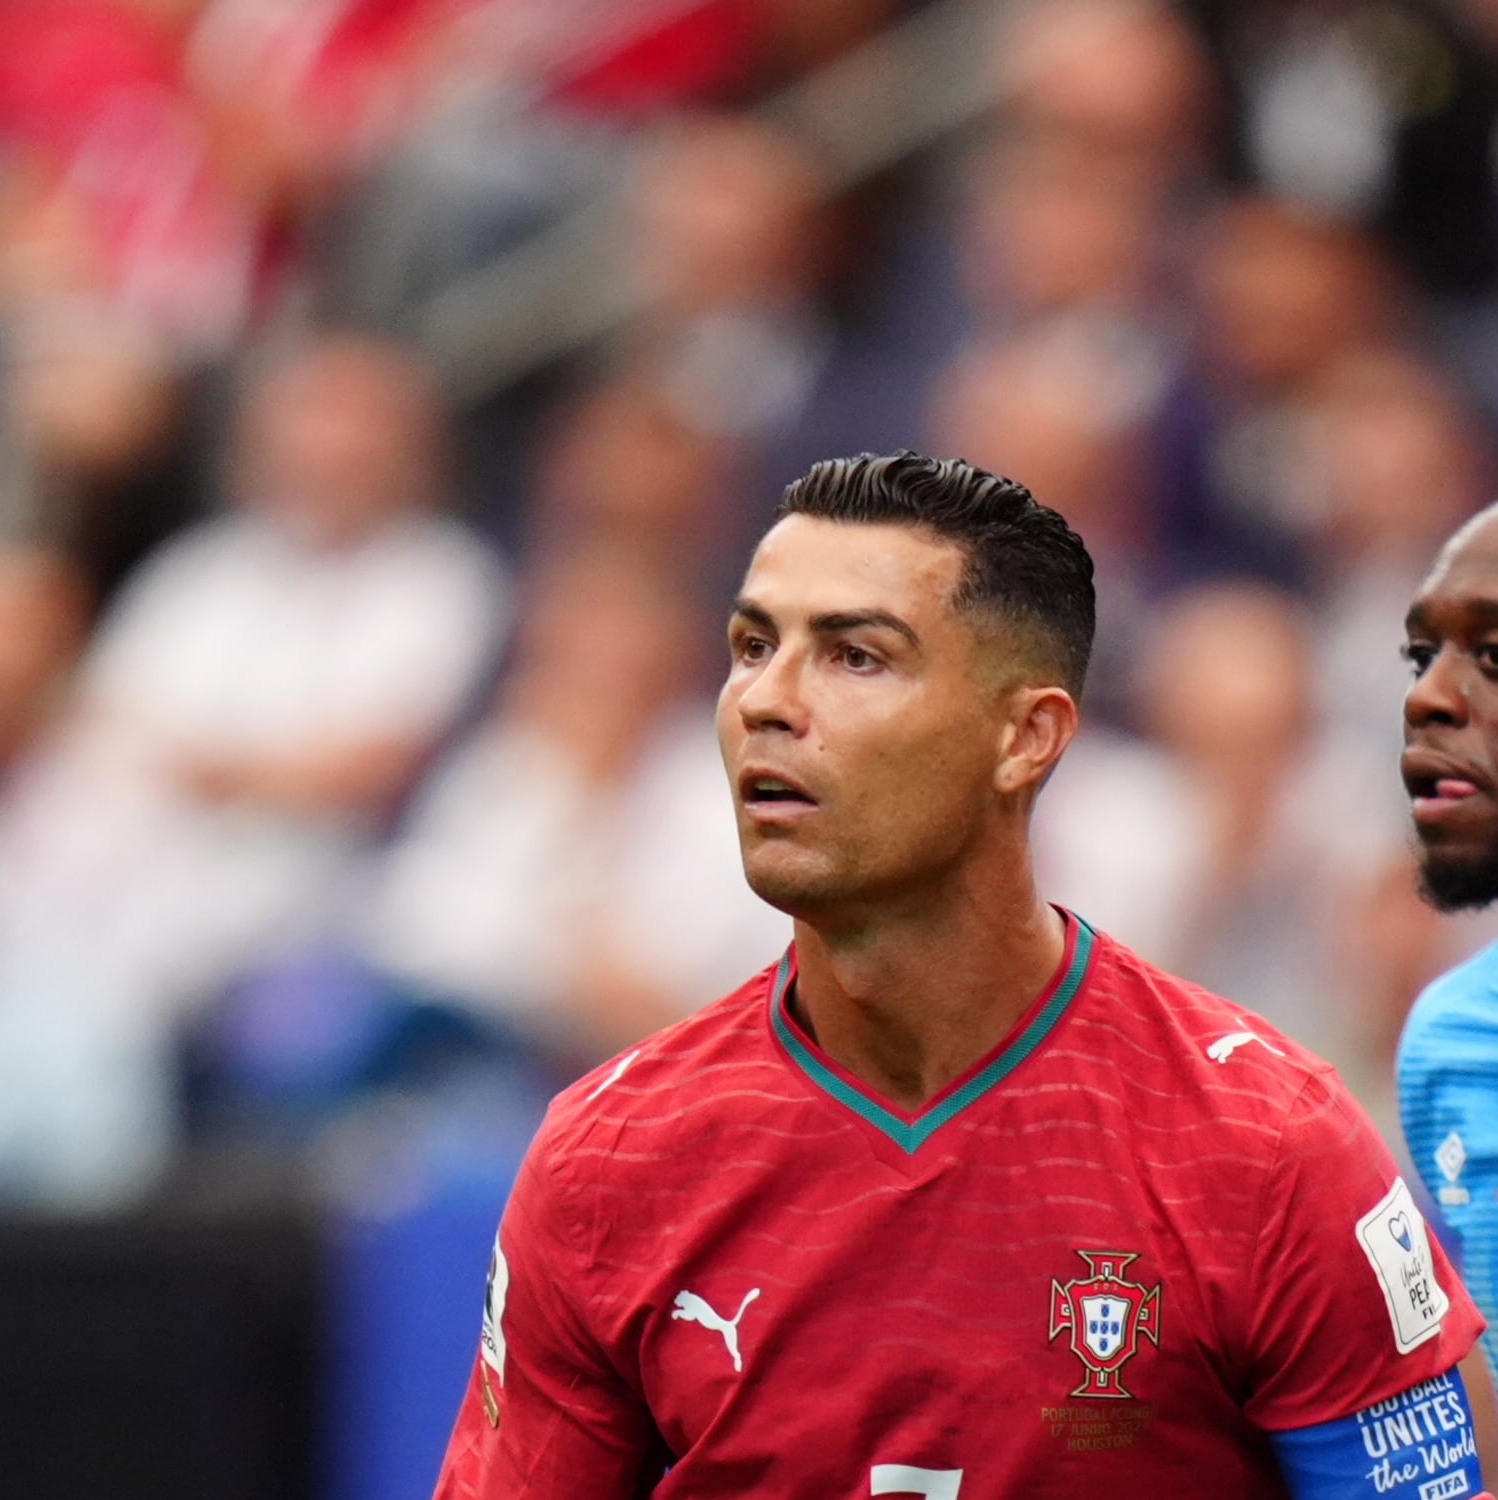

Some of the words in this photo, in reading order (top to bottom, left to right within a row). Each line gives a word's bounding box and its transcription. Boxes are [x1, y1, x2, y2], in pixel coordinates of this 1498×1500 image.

[1409, 1278, 1431, 1311] PEA
[1116, 1421, 1147, 1434] 202
[1361, 1391, 1467, 1459] UNITES
[1067, 1433, 1134, 1452] HOUSTON
[1364, 1458, 1420, 1494] the
[1418, 1426, 1478, 1475] World
